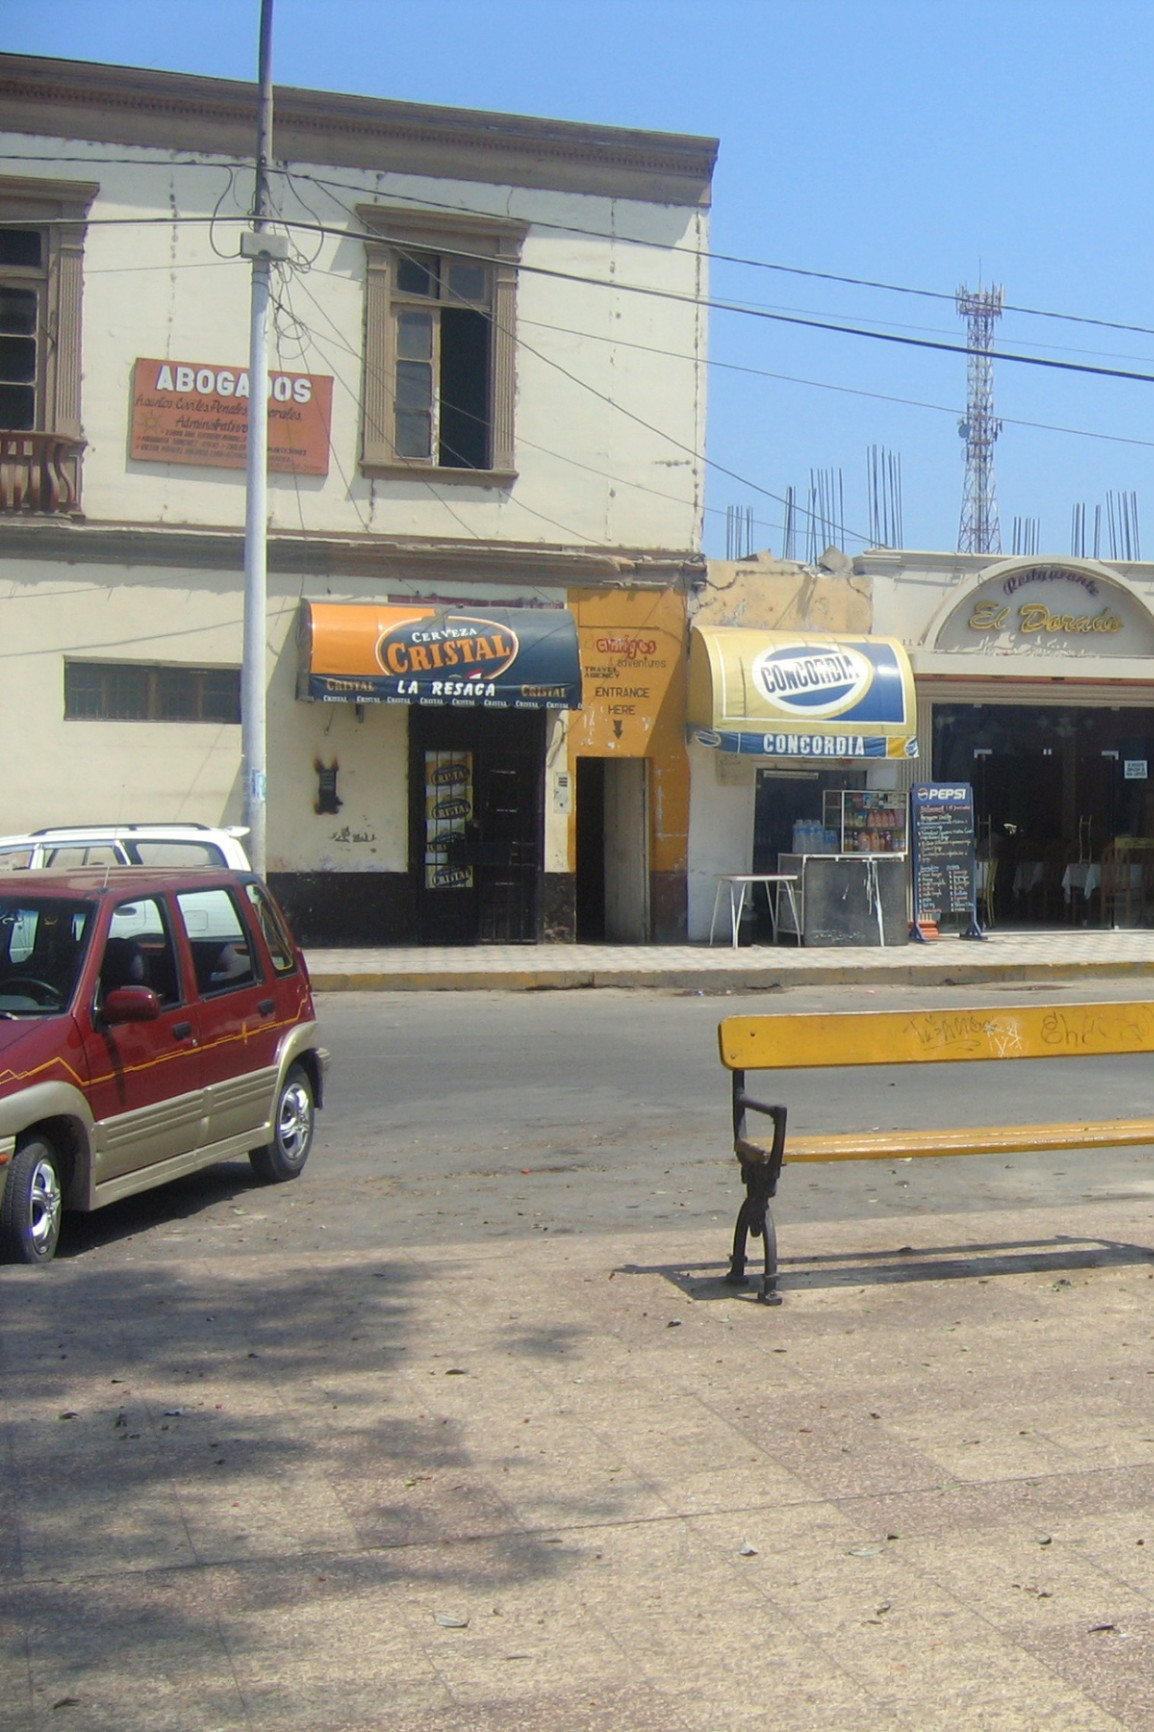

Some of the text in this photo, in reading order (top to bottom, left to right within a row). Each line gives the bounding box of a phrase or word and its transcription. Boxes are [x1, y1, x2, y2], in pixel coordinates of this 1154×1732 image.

[156, 365, 312, 403] ABOGAOS
[969, 600, 1124, 634] El Dorado
[411, 627, 477, 643] CERVEZA
[386, 634, 511, 675] CRISTAL
[760, 654, 860, 694] CONCORDIA
[326, 678, 375, 692] CRISTAL
[397, 680, 496, 697] LA RESACA
[520, 684, 567, 698] CRISTAL
[595, 686, 650, 698] ENTRANCE
[608, 704, 636, 715] HERE
[763, 733, 865, 756] CONCORDIA
[928, 788, 967, 800] PEPSI
